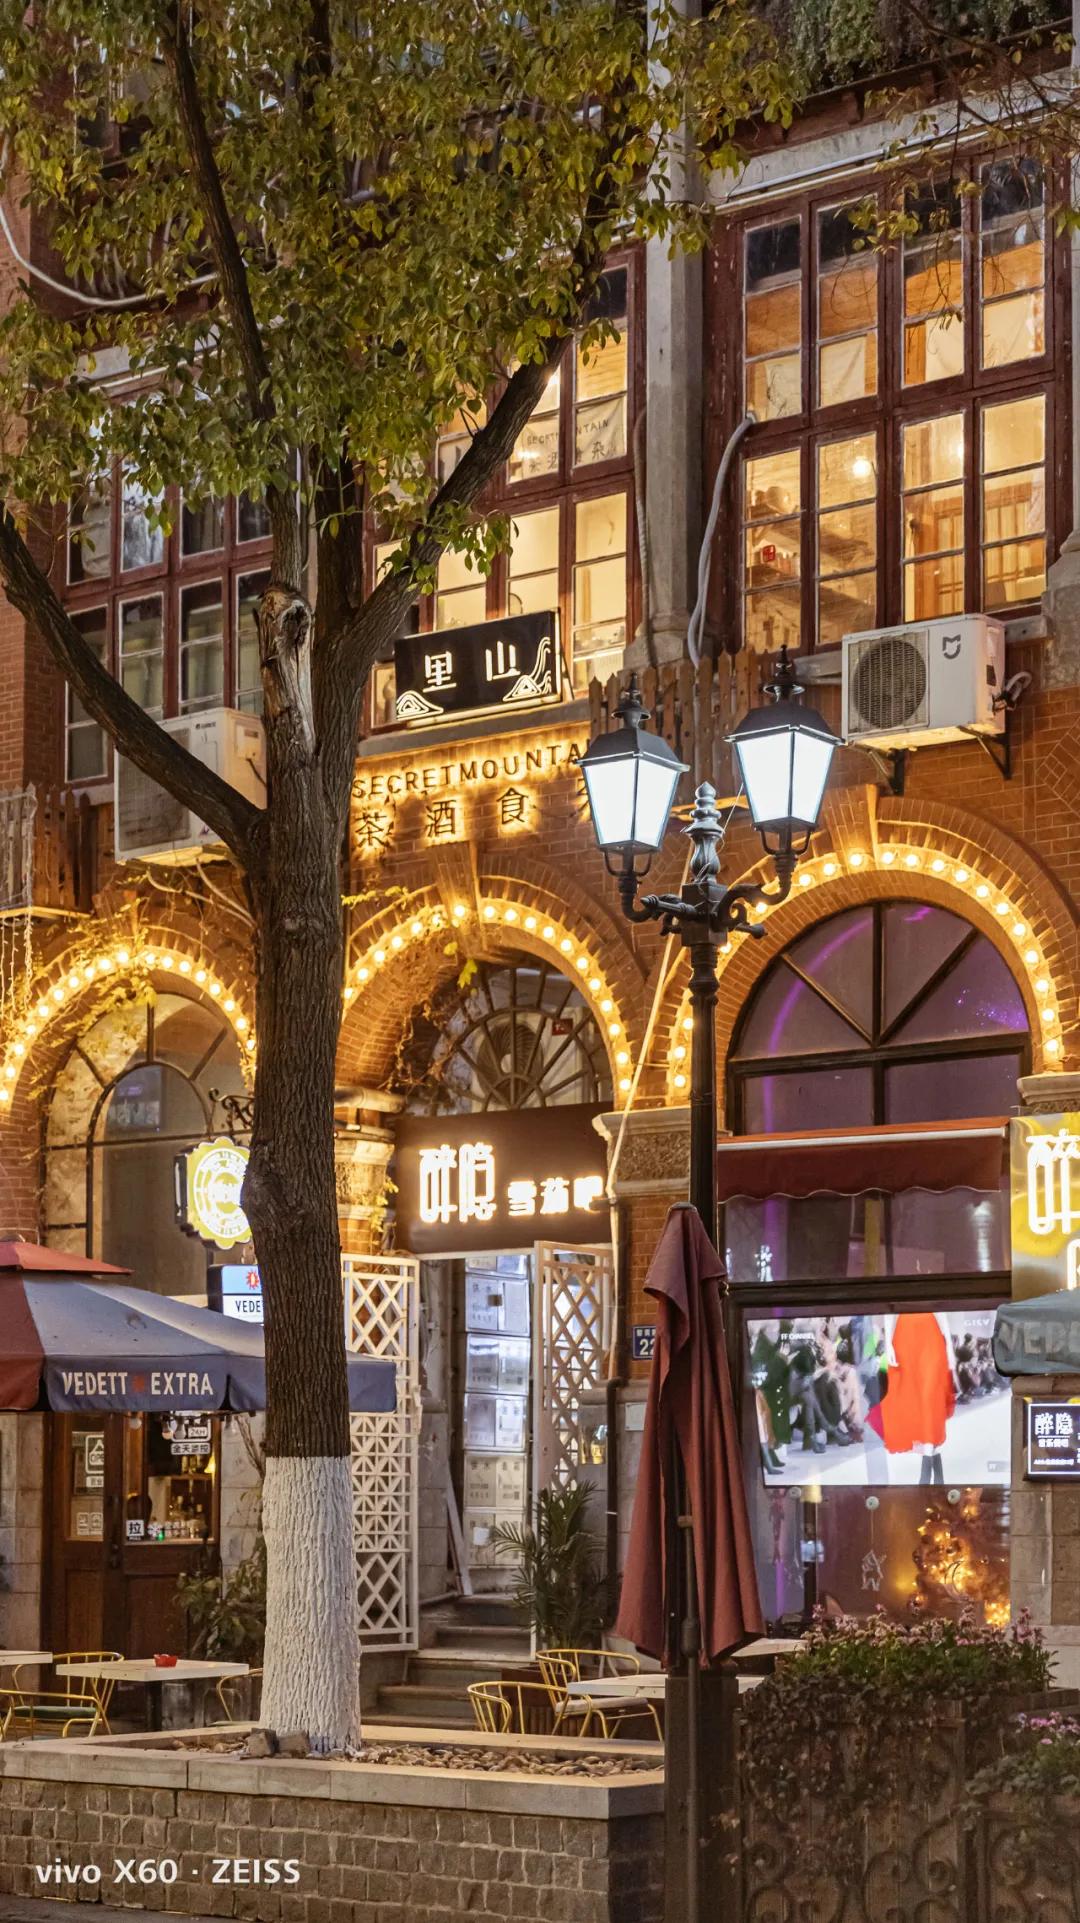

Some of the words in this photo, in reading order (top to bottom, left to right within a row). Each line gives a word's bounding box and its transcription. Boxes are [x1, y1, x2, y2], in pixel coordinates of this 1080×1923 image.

[423, 640, 521, 693] 里山
[352, 738, 590, 800] SECRETMOUNTA
[354, 776, 592, 848] 茶酒食
[507, 1175, 604, 1218] 雪茄吧
[61, 1371, 128, 1396] VEDETT
[151, 1371, 214, 1396] EXTRA
[1034, 1412, 1074, 1436] 醉隐
[128, 1522, 142, 1536] 拉
